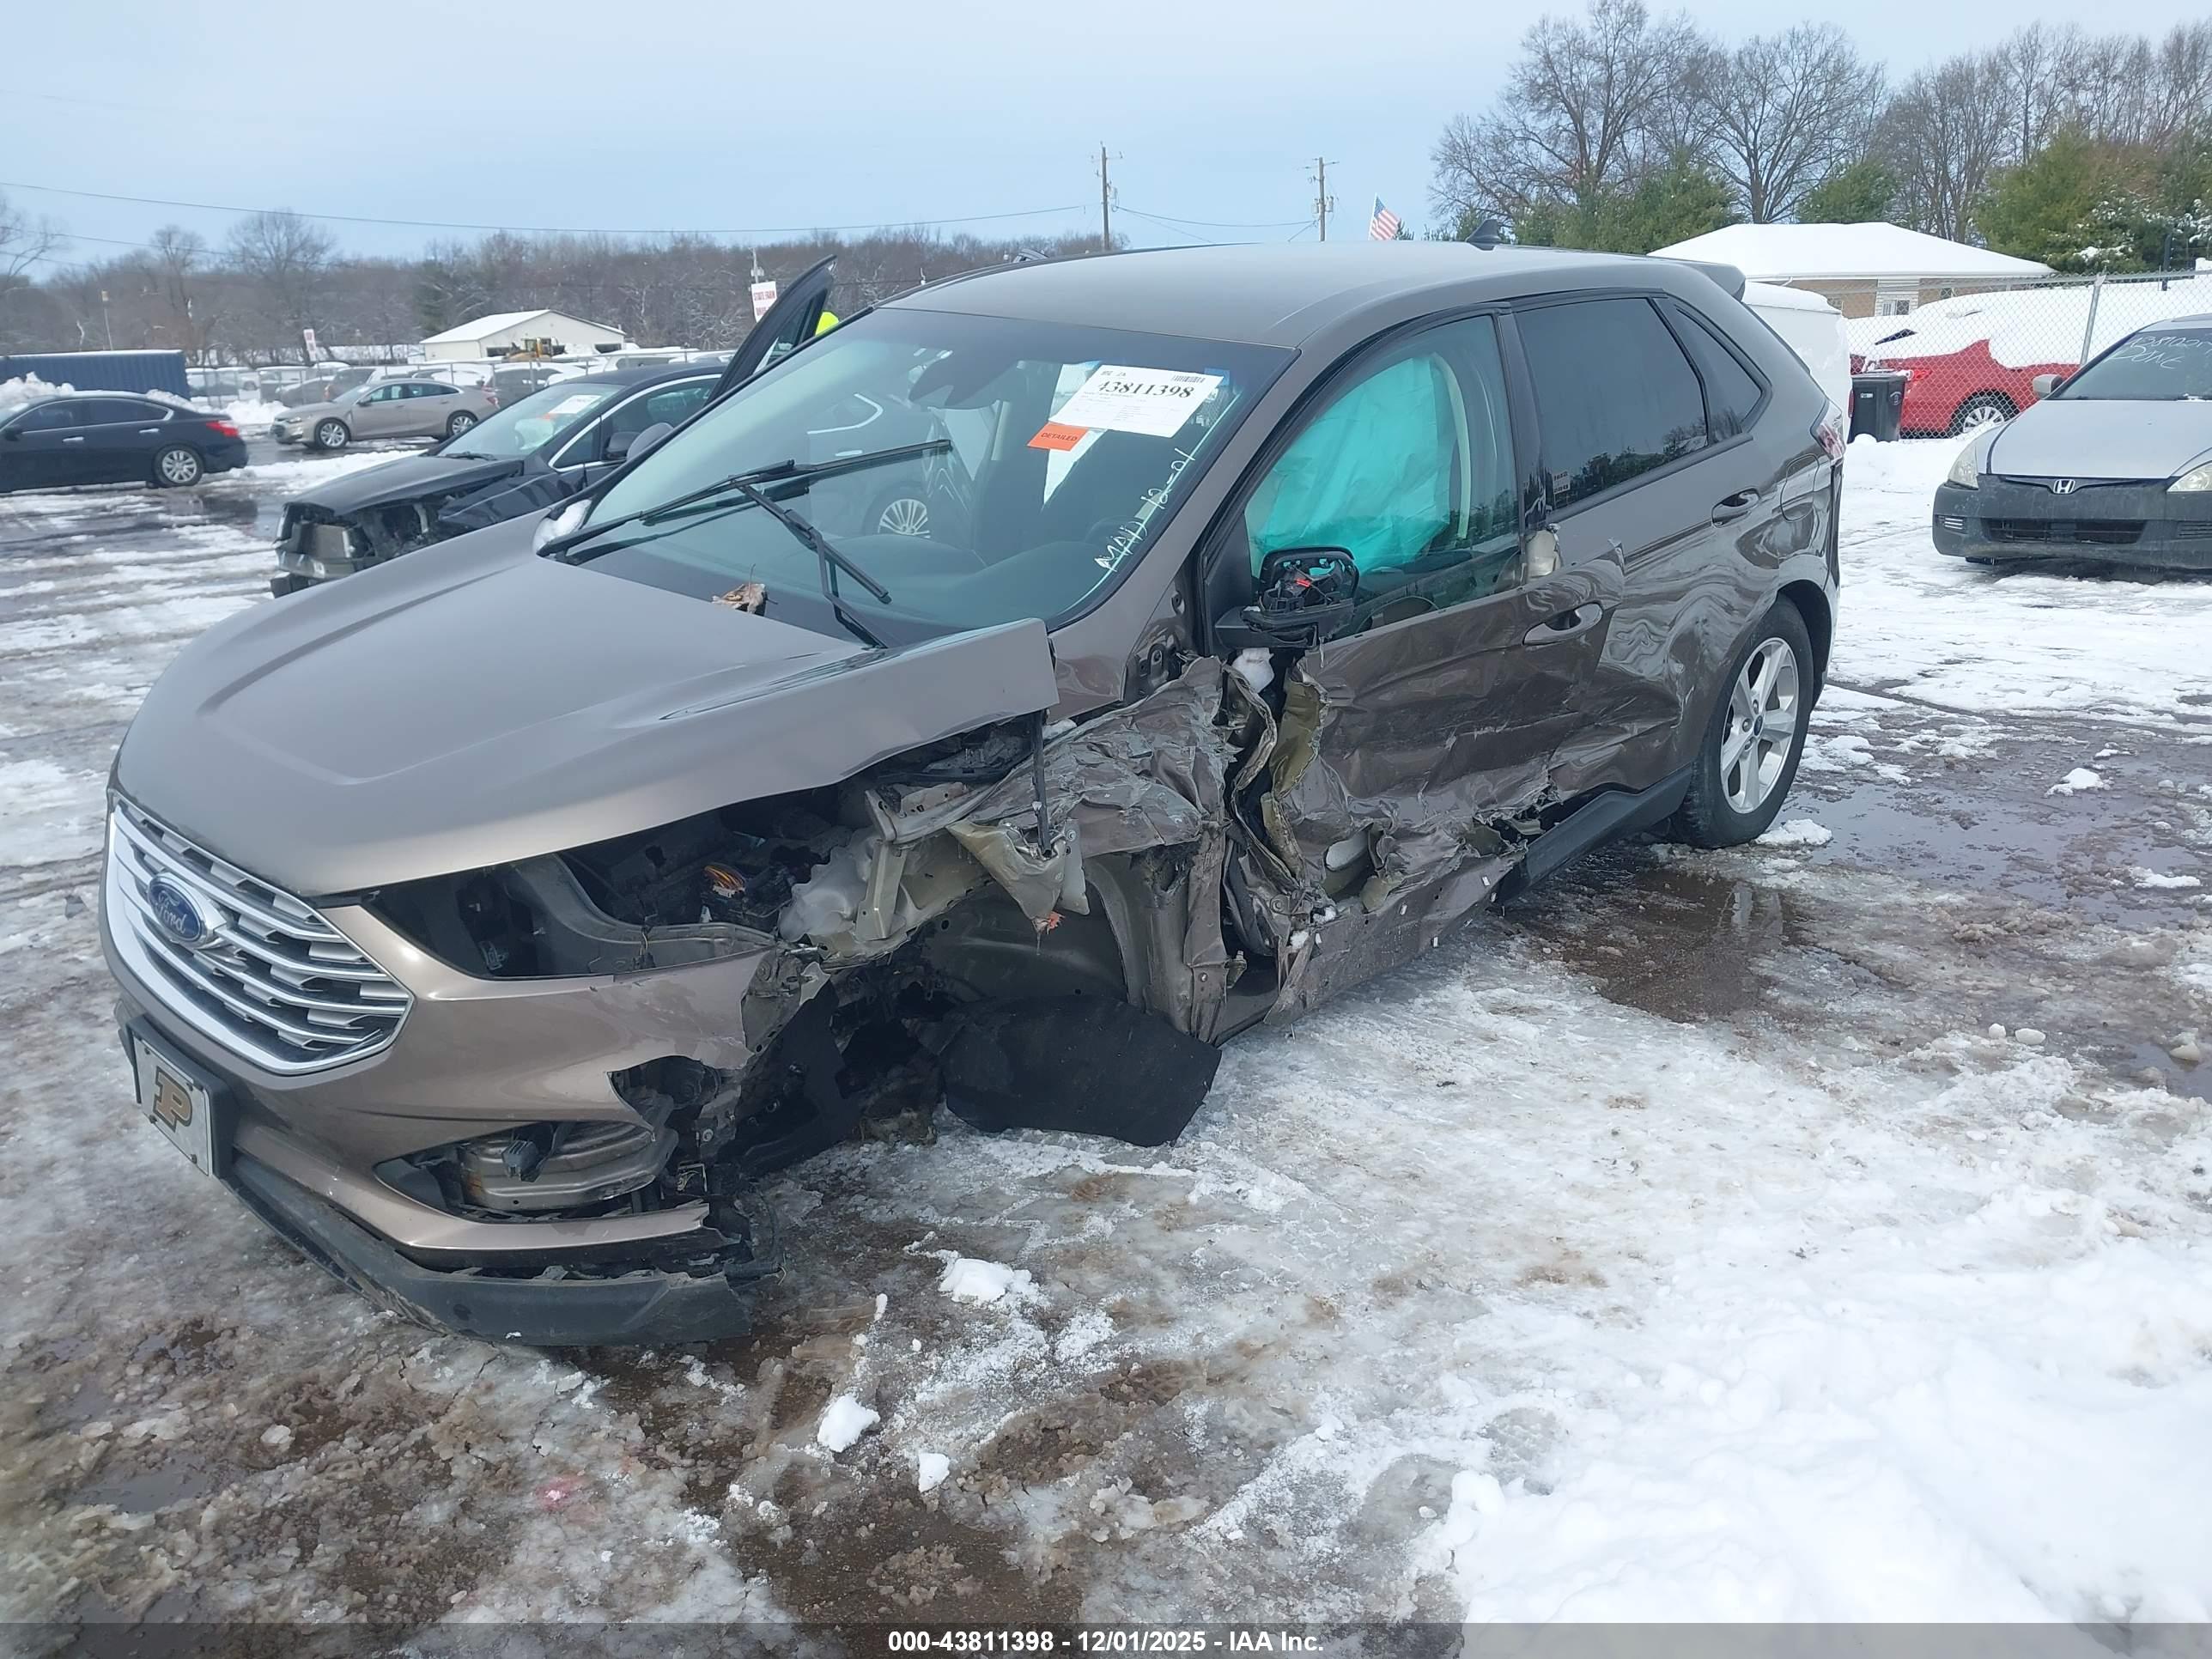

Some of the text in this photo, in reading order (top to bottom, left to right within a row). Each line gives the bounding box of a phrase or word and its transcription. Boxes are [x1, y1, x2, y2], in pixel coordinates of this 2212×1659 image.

[1098, 380, 1195, 398] 43811398
[1041, 432, 1078, 441] DETAILED
[155, 890, 188, 934] Ford
[153, 1066, 192, 1133] P
